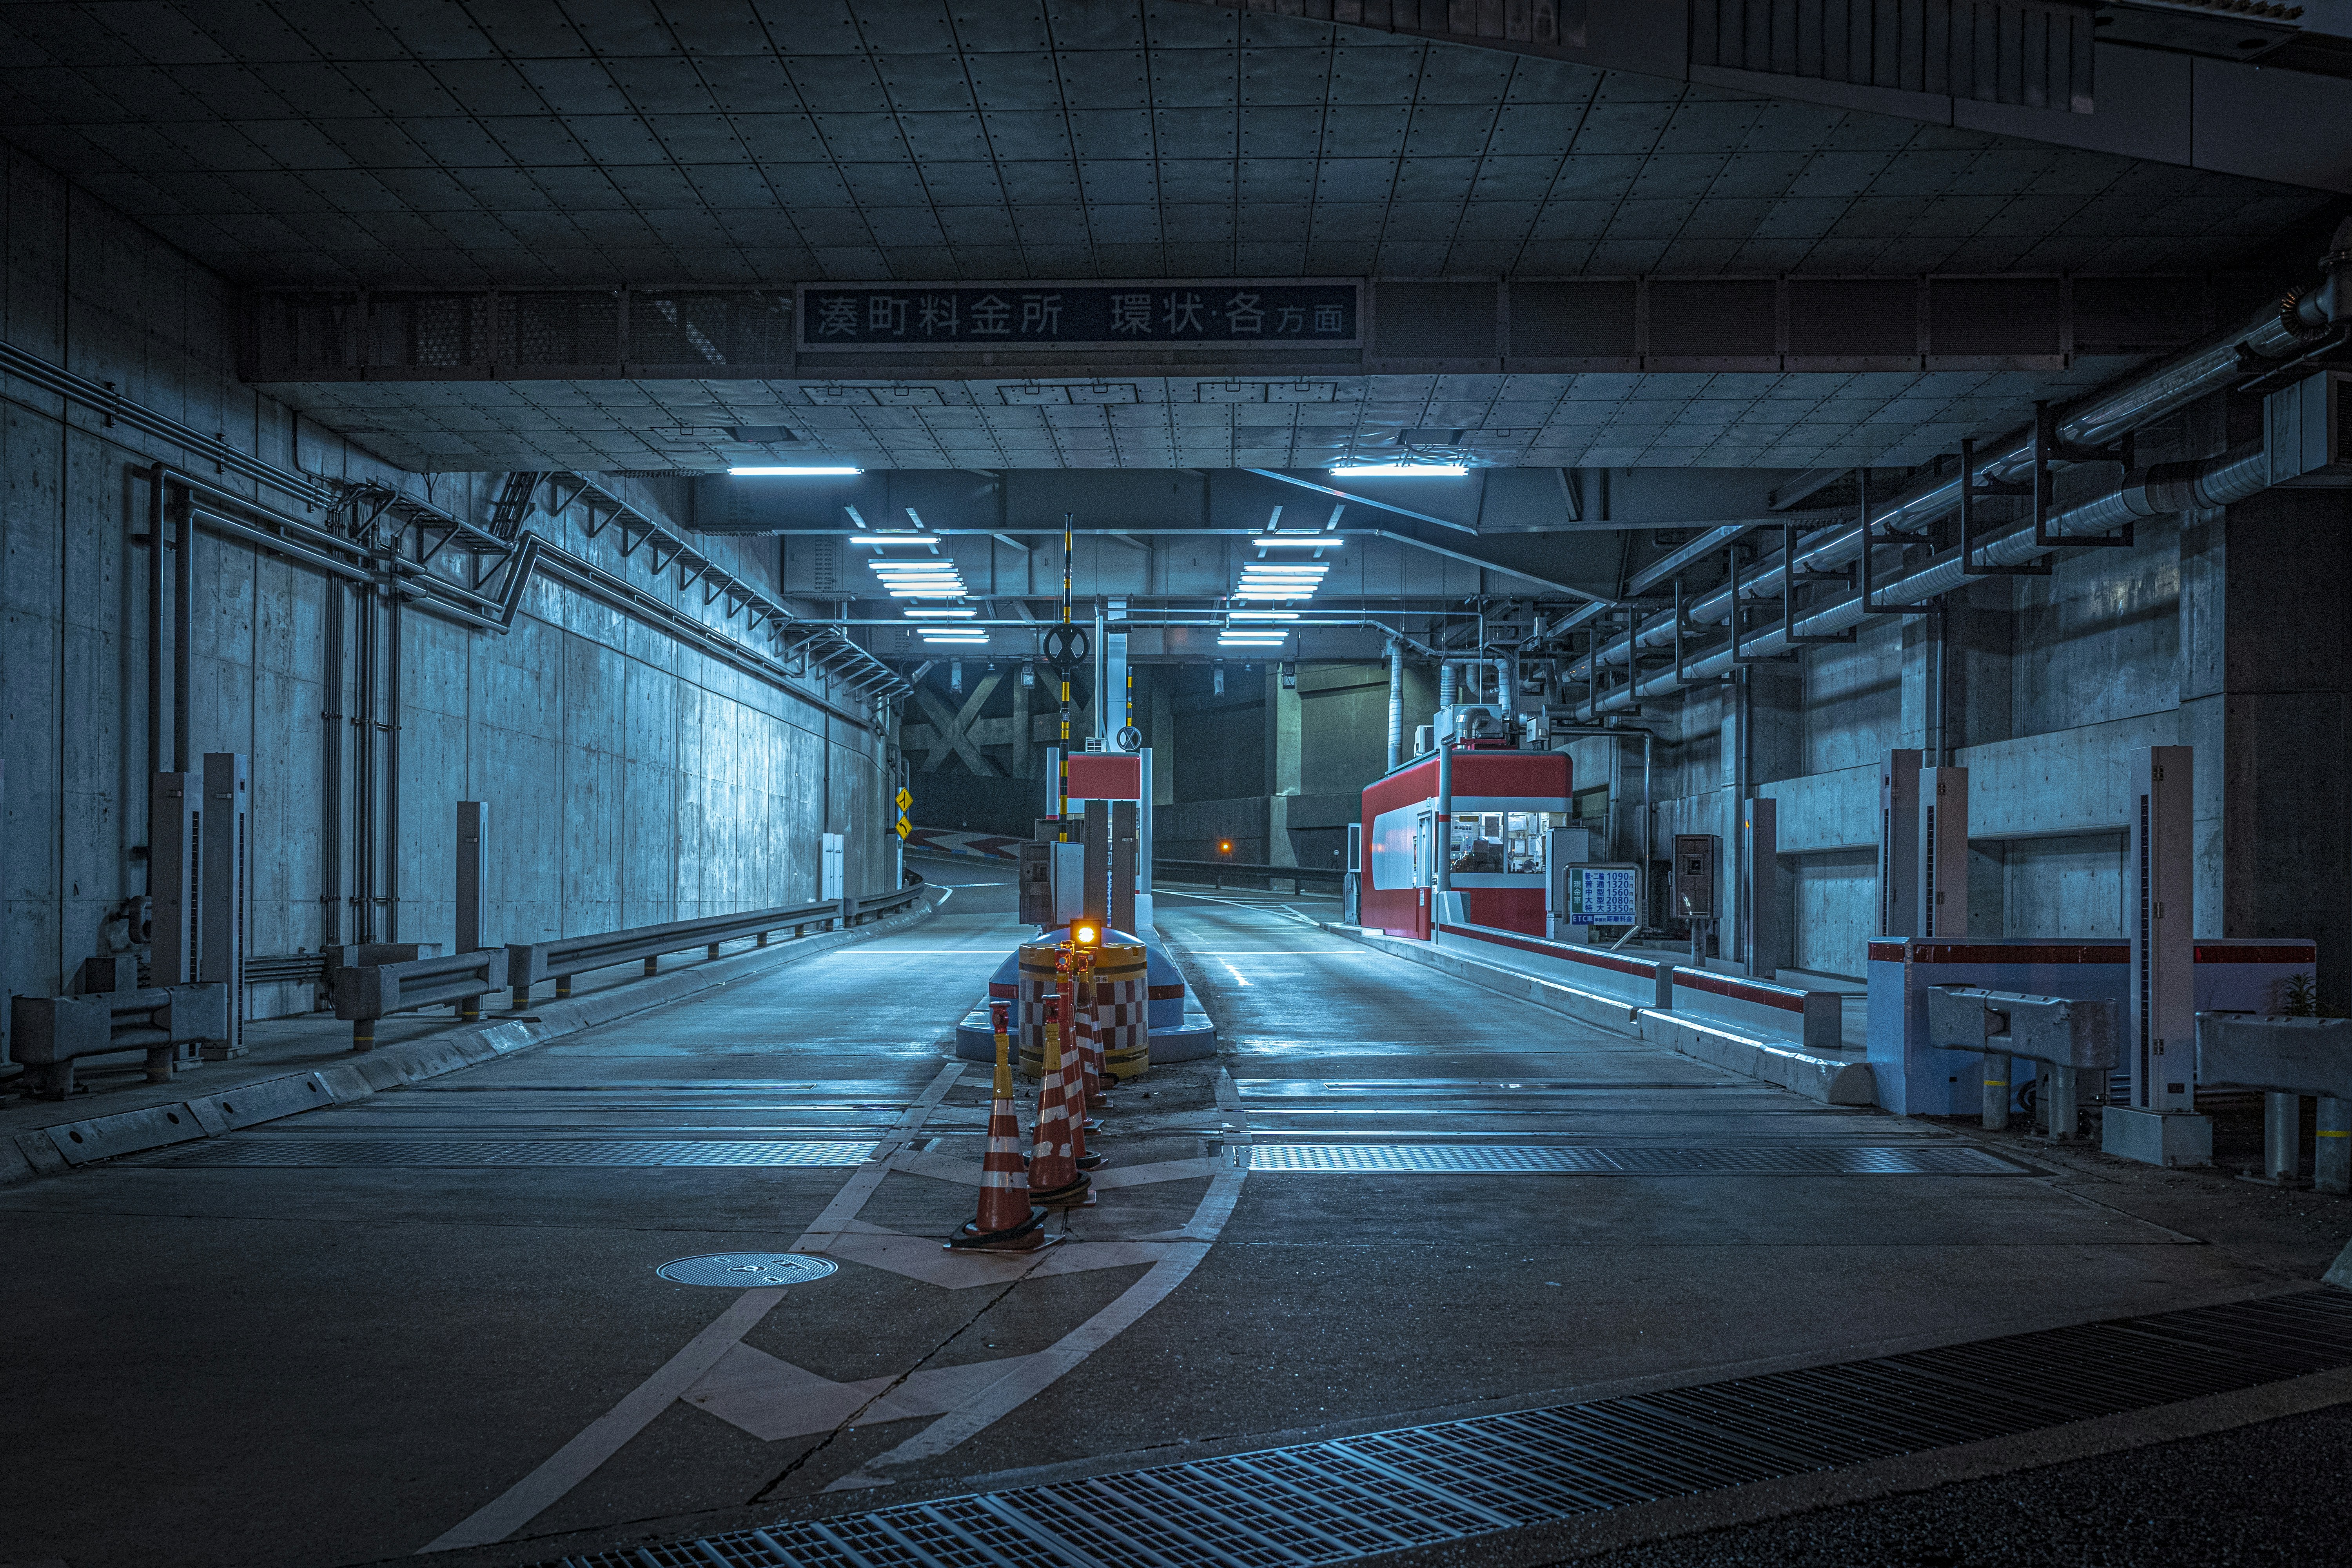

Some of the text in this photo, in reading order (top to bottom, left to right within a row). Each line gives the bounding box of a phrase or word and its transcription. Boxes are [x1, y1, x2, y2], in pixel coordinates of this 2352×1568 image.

[818, 294, 1063, 336] 湊町料金所
